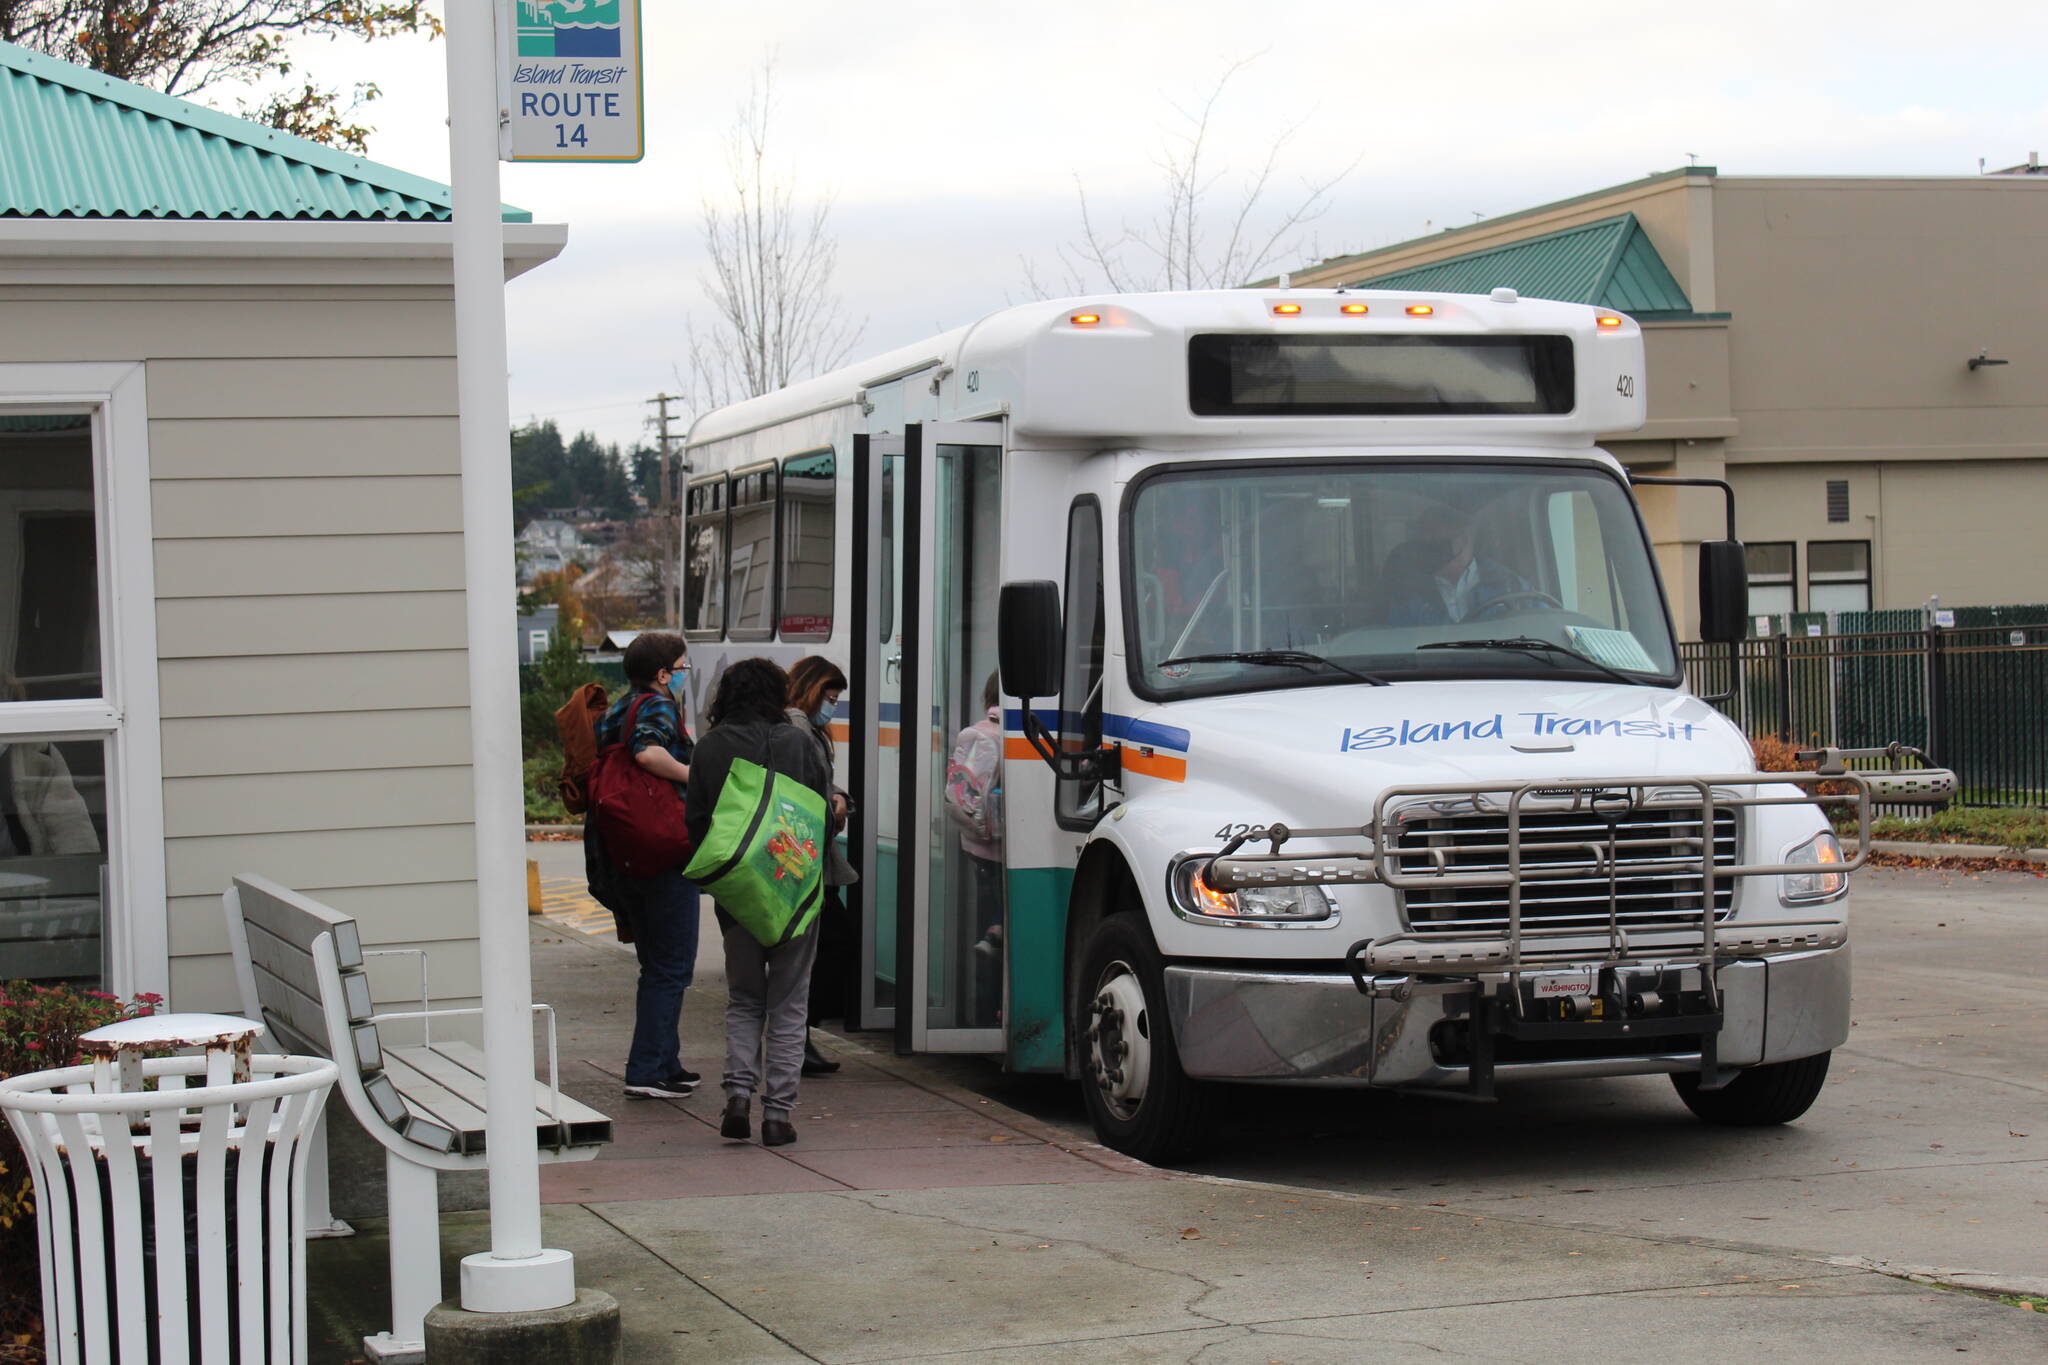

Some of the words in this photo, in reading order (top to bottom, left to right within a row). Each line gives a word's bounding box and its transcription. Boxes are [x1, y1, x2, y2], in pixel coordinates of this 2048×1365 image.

[513, 63, 566, 84] Island
[570, 63, 627, 85] Transit
[521, 92, 620, 117] ROUTE
[555, 123, 588, 148] 14
[1616, 374, 1634, 398] 420
[1340, 714, 1503, 752] Island
[1519, 712, 1706, 741] Transit
